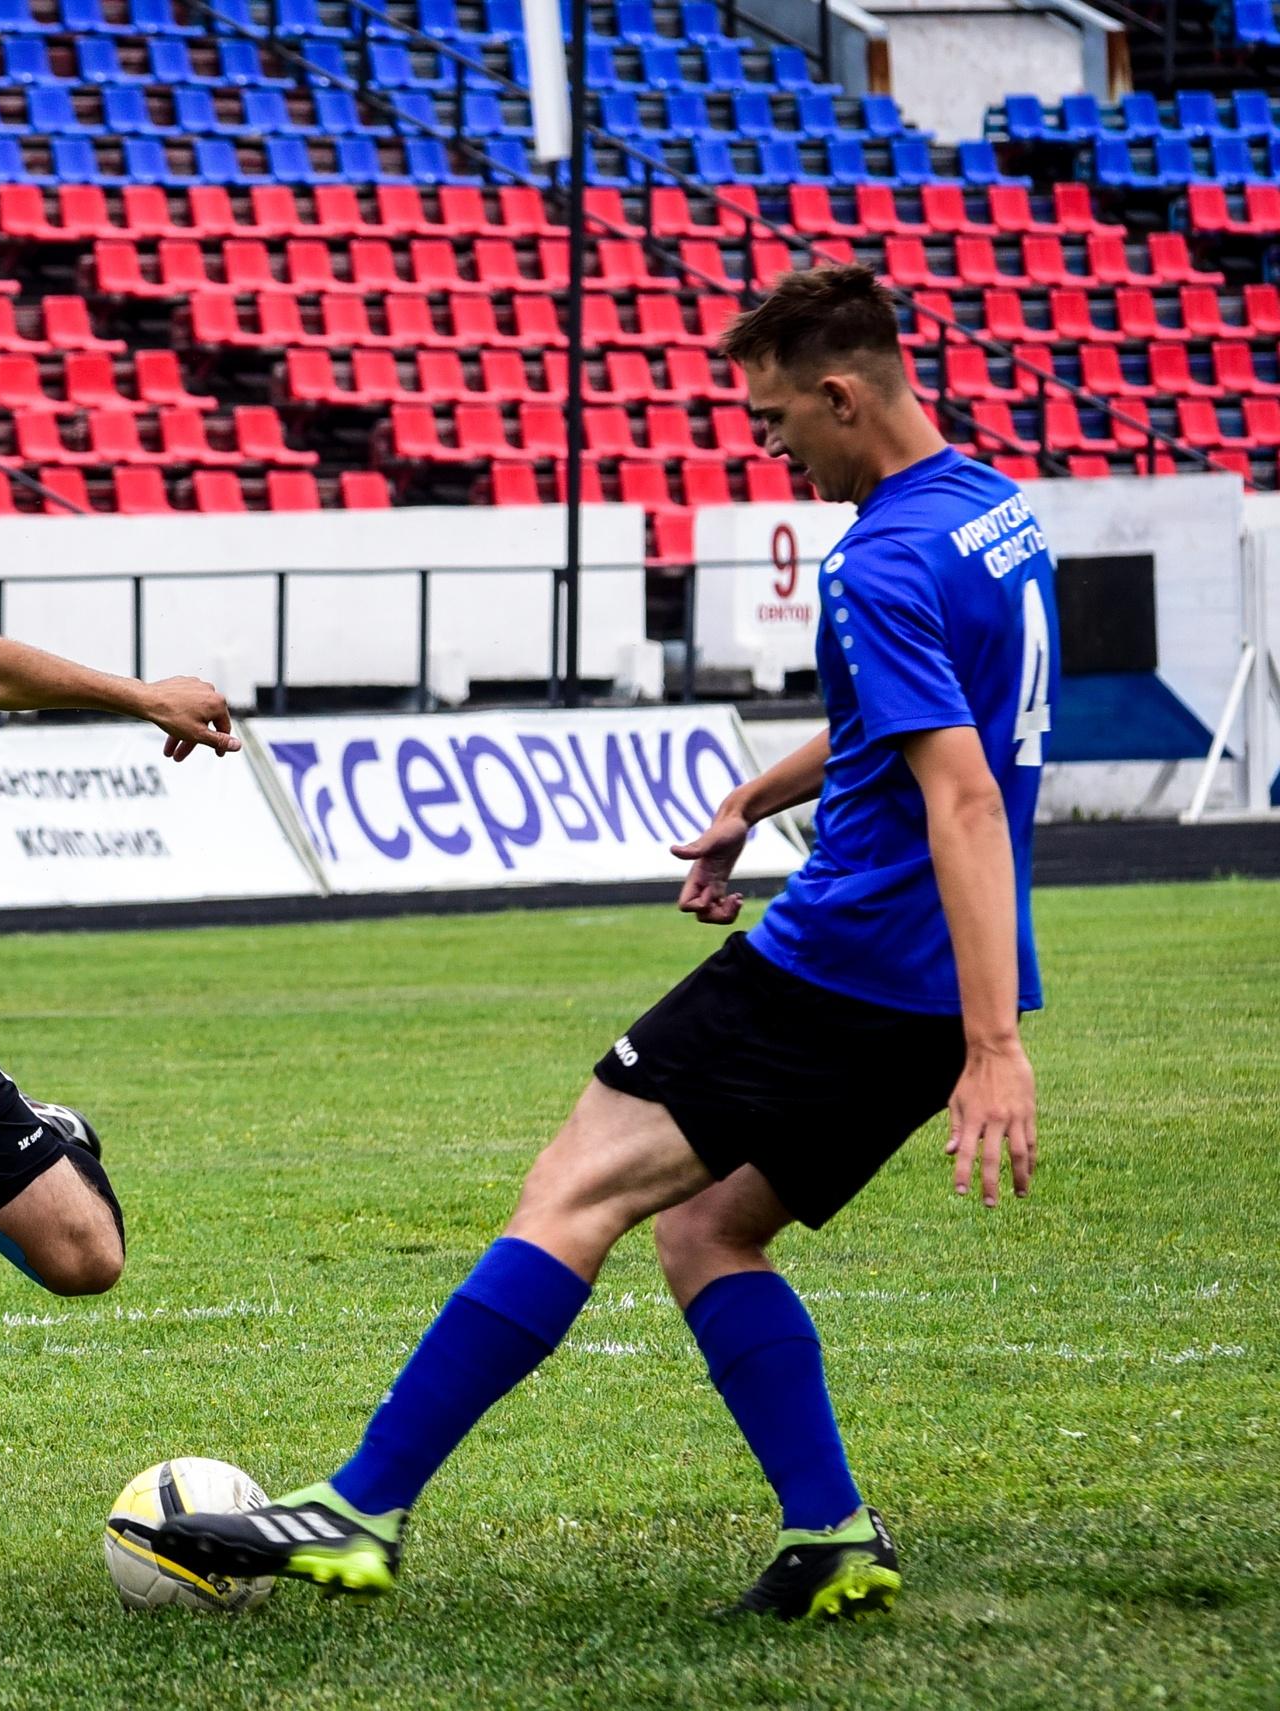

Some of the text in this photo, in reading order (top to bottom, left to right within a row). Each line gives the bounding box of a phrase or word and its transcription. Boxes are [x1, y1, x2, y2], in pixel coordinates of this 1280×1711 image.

[949, 491, 1031, 557] ИРКУТСКА
[771, 524, 797, 599] 9
[1013, 578, 1051, 766] 4
[16, 828, 170, 858] КОМПАНИЯ
[614, 1035, 639, 1067] AKO
